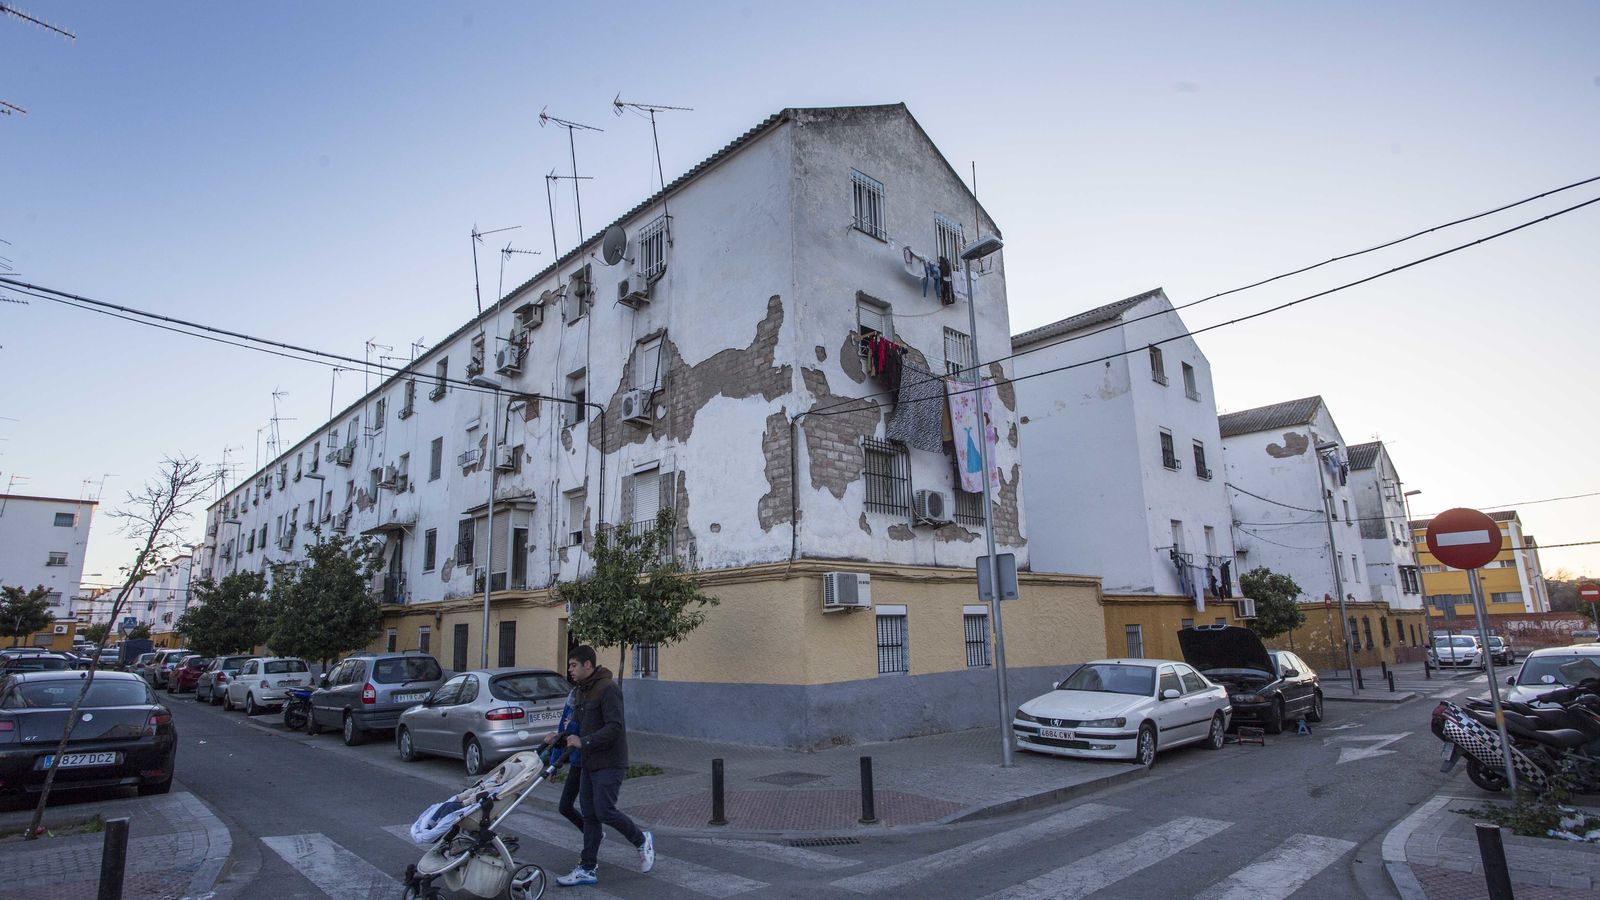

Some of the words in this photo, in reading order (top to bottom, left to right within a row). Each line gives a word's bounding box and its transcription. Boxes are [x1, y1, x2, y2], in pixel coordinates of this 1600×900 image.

[533, 713, 541, 721] SE
[1042, 729, 1058, 738] 4684
[59, 754, 86, 766] 827
[89, 753, 114, 764] DCZ
